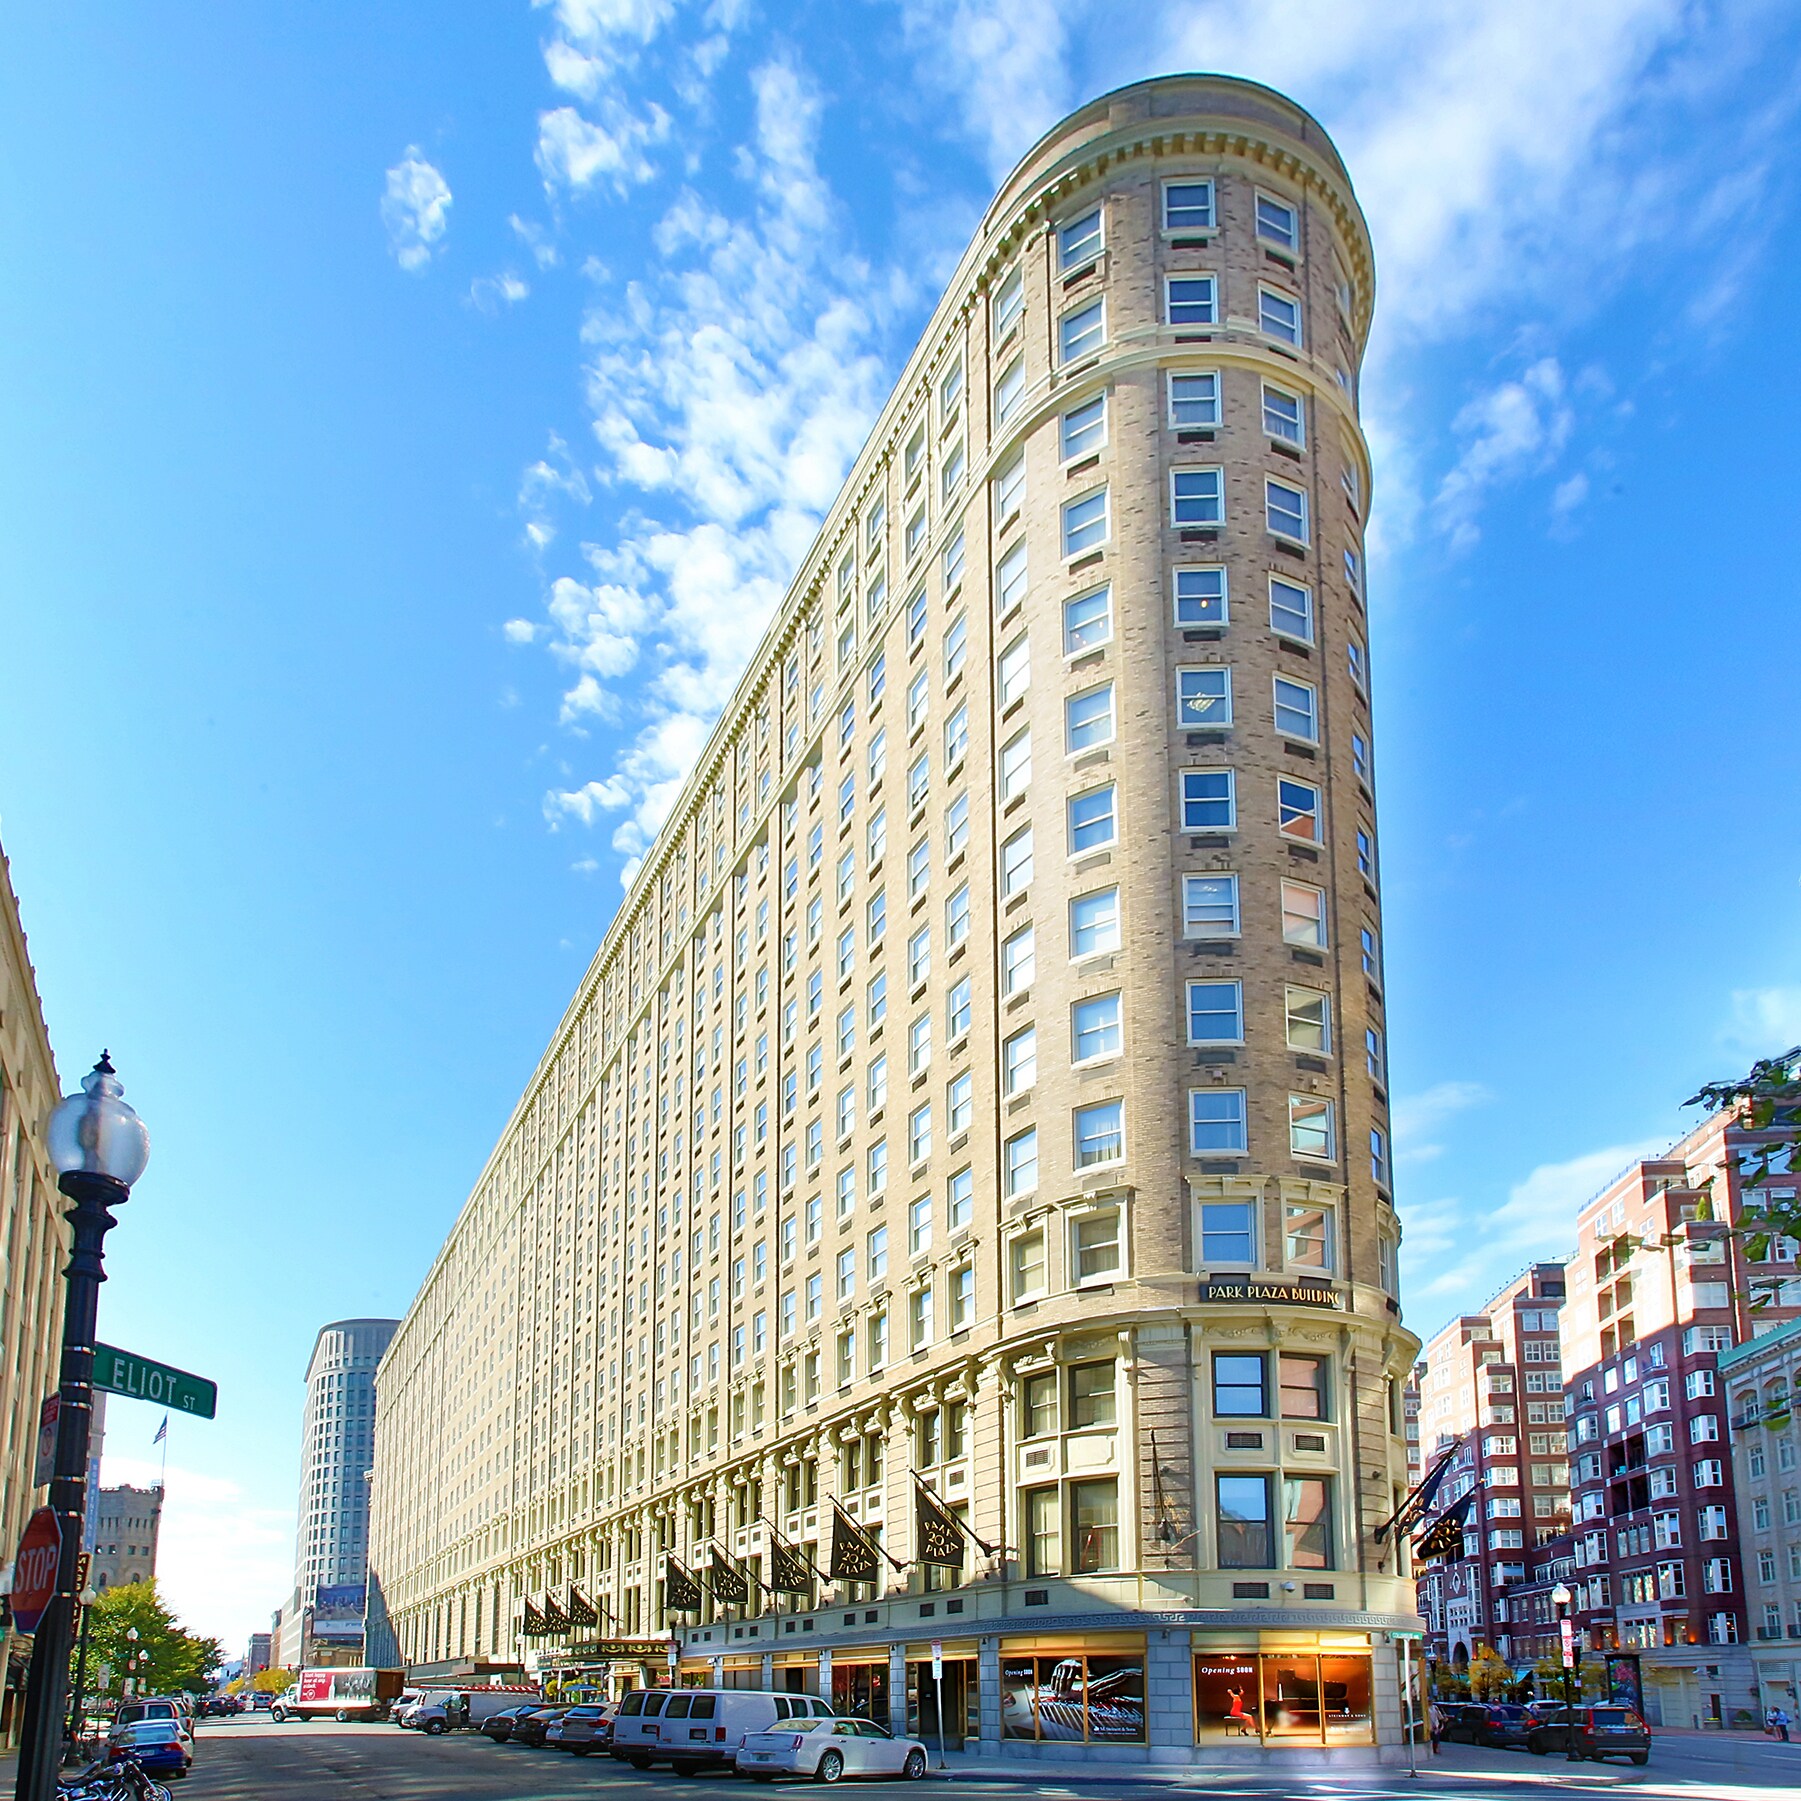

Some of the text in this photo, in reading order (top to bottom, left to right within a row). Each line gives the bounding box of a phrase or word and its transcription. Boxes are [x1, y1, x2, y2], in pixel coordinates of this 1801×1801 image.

[1208, 1285, 1244, 1299] PARK
[1247, 1285, 1289, 1300] PLAZA
[112, 1357, 196, 1411] ELIOT ST
[924, 1520, 954, 1538] PARK
[928, 1531, 945, 1546] 20
[839, 1541, 868, 1557] PARK
[925, 1541, 959, 1558] PLAZA
[841, 1551, 859, 1564] 20
[15, 1544, 58, 1595] STOP
[837, 1560, 873, 1575] PLAZA
[1201, 1666, 1253, 1676] Opening SOON
